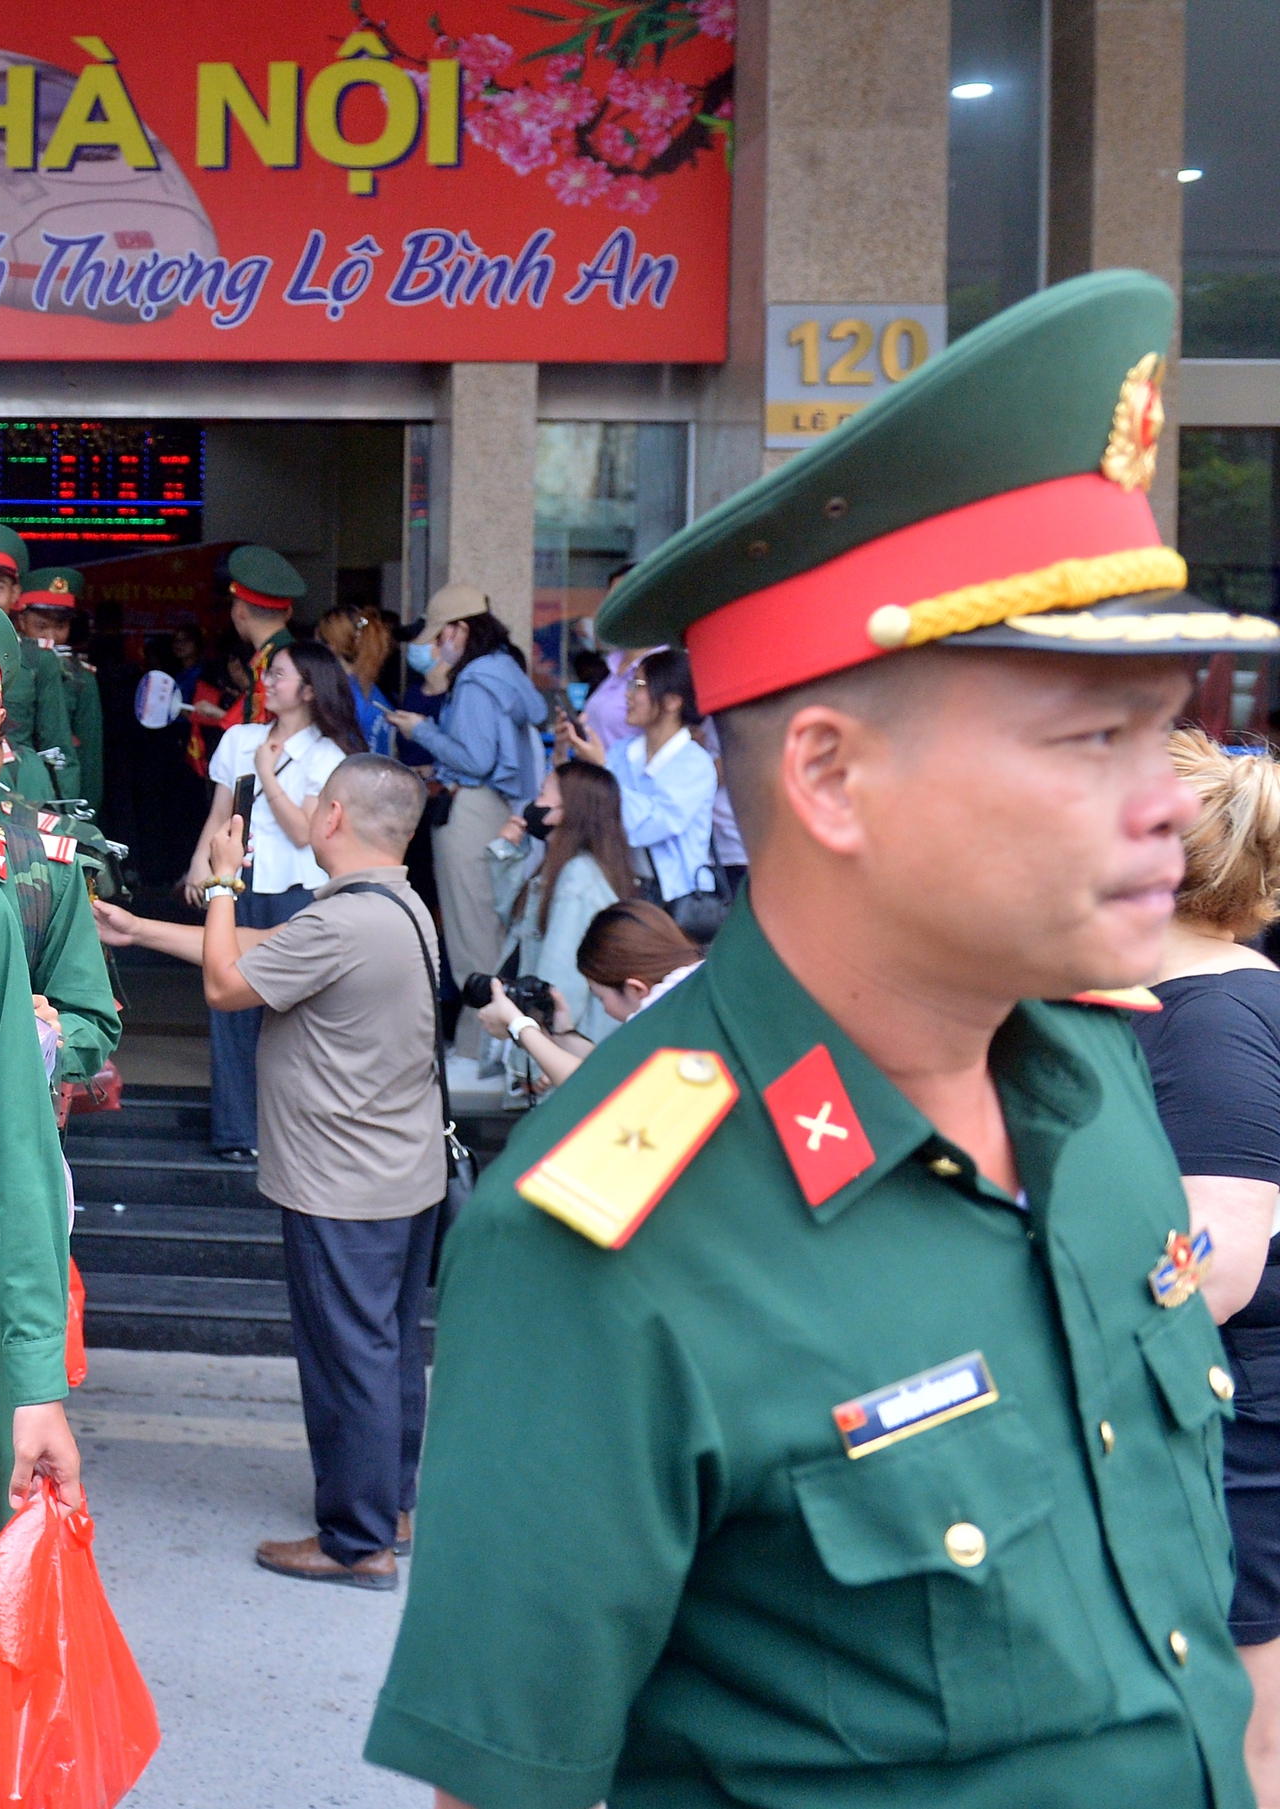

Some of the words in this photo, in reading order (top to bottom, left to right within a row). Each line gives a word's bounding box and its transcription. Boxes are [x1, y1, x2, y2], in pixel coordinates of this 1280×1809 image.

[196, 31, 464, 197] NỘI
[32, 231, 273, 329] Thượng
[283, 228, 384, 322] Lộ
[387, 228, 555, 309] Bình
[564, 226, 680, 309] An
[788, 317, 929, 386] 120
[793, 409, 828, 430] LÊ
